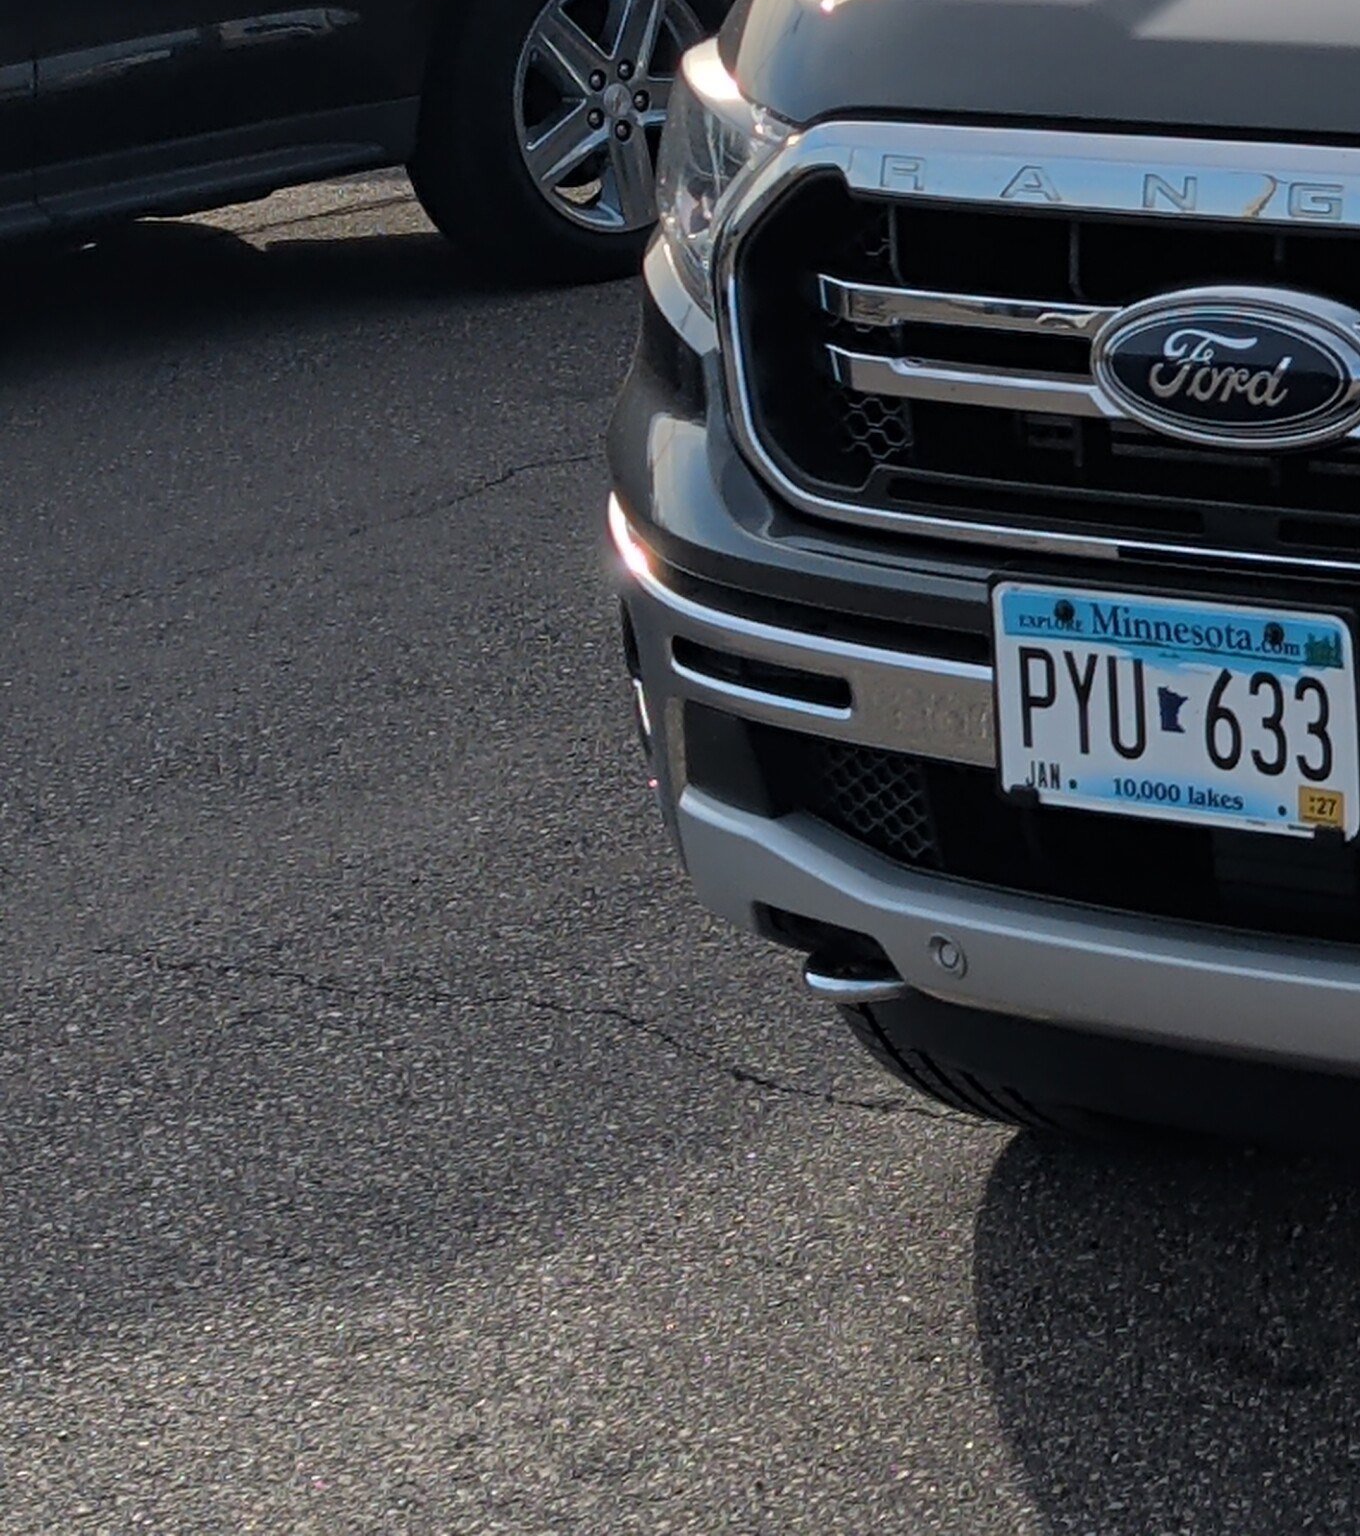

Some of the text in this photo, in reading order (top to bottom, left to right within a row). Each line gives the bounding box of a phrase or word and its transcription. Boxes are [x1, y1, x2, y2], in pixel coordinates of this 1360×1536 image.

[1150, 329, 1292, 406] Ford
[1018, 646, 1333, 782] PYU 633
[1025, 761, 1060, 790] JAN
[1113, 777, 1244, 812] 10,000 lakes
[1317, 797, 1338, 816] 27
